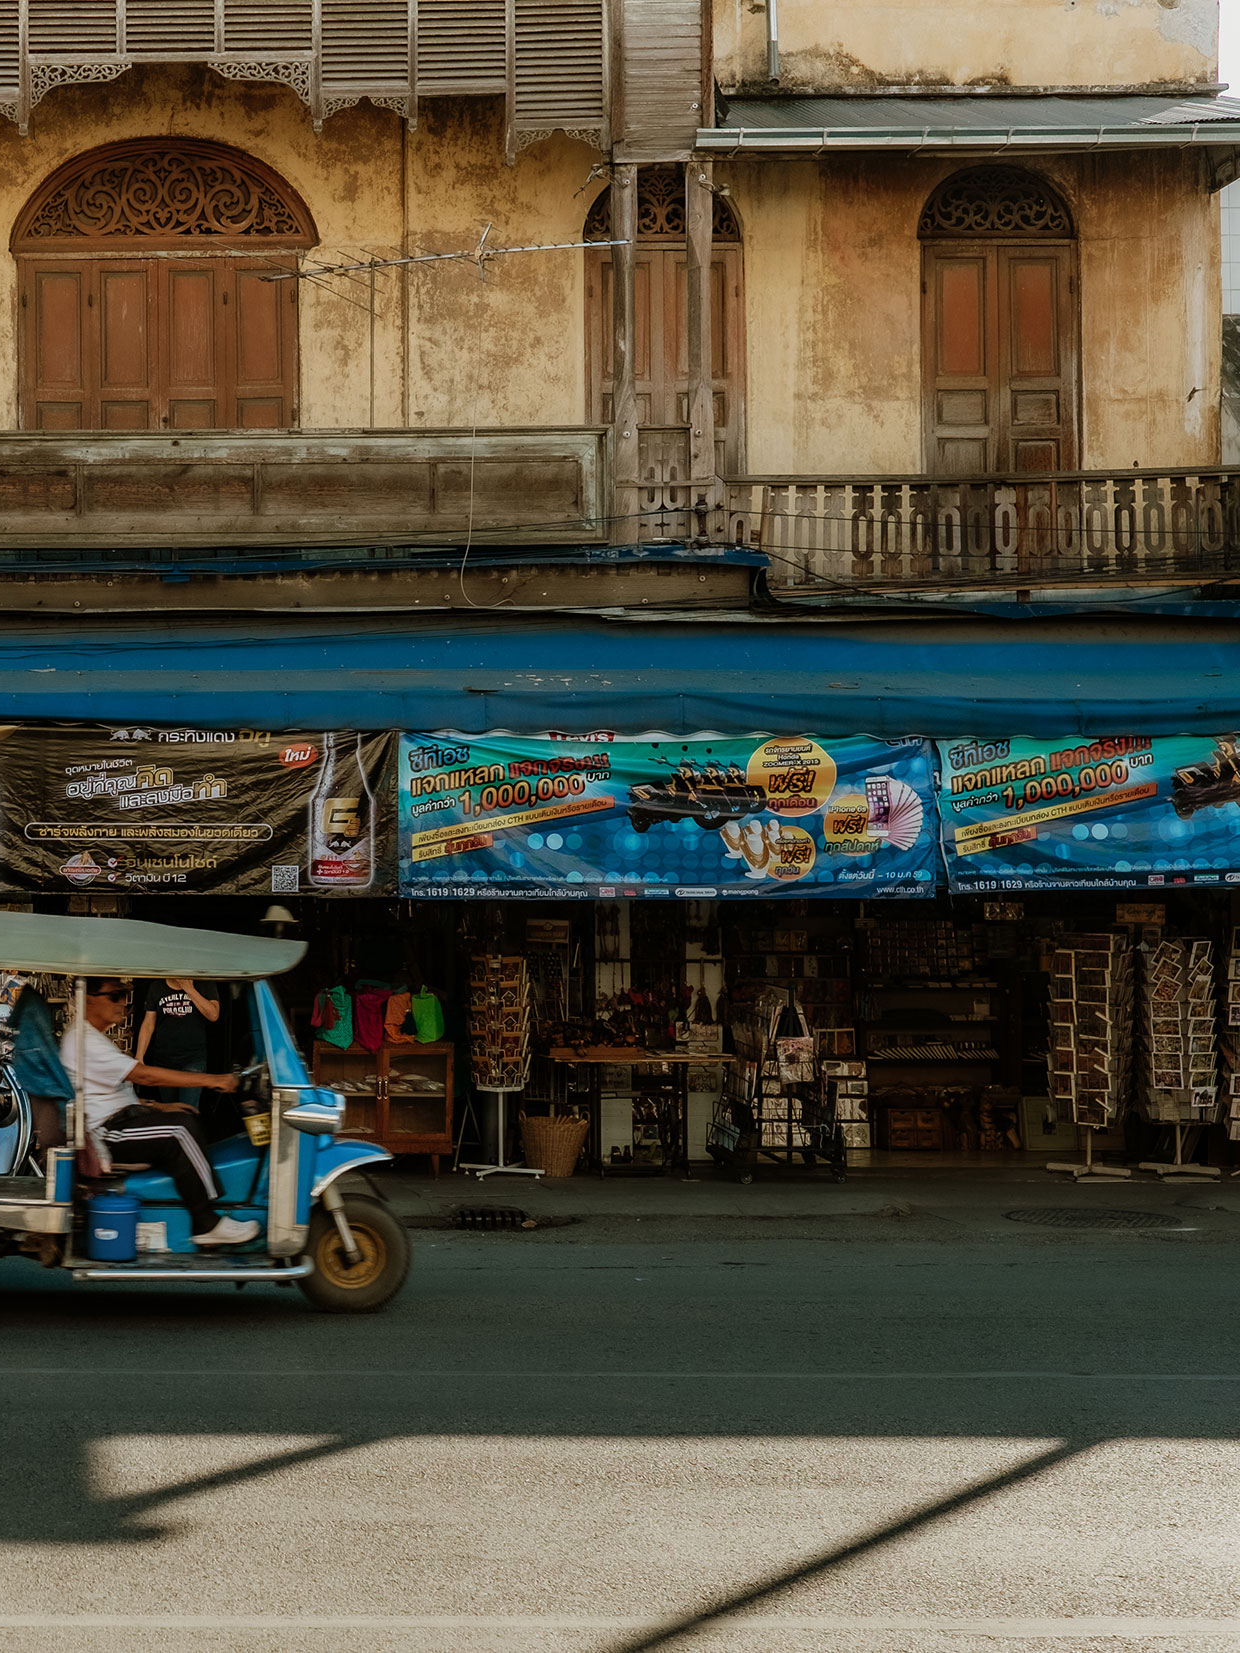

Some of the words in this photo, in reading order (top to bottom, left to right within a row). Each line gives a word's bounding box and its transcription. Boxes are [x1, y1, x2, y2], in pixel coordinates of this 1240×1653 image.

[158, 730, 235, 743] กระทิงแดง
[284, 747, 312, 763] ใหม่
[410, 745, 470, 772] ซีทีเอช
[949, 739, 1010, 770] ซีทีเอช
[411, 763, 504, 797] แจกแหลก
[769, 767, 816, 793] ฟรี!
[951, 756, 1045, 795] แจกแหลก
[952, 793, 998, 812] มูลค่ากว่า
[1002, 760, 1129, 810] 1,000,000
[1129, 753, 1153, 768] บาท
[412, 797, 456, 818] มูลค่ากว่า
[458, 774, 585, 817] 1,000,000
[586, 770, 610, 783] บาท
[507, 815, 524, 825] CTH
[1051, 807, 1067, 817] CTH
[833, 815, 866, 834] ฟรี!
[780, 846, 812, 864] ฟรี!
[172, 874, 187, 883] 12
[974, 881, 996, 890] 1619
[1001, 880, 1022, 889] 1629
[426, 888, 448, 897] 1619
[452, 888, 475, 897] 1629
